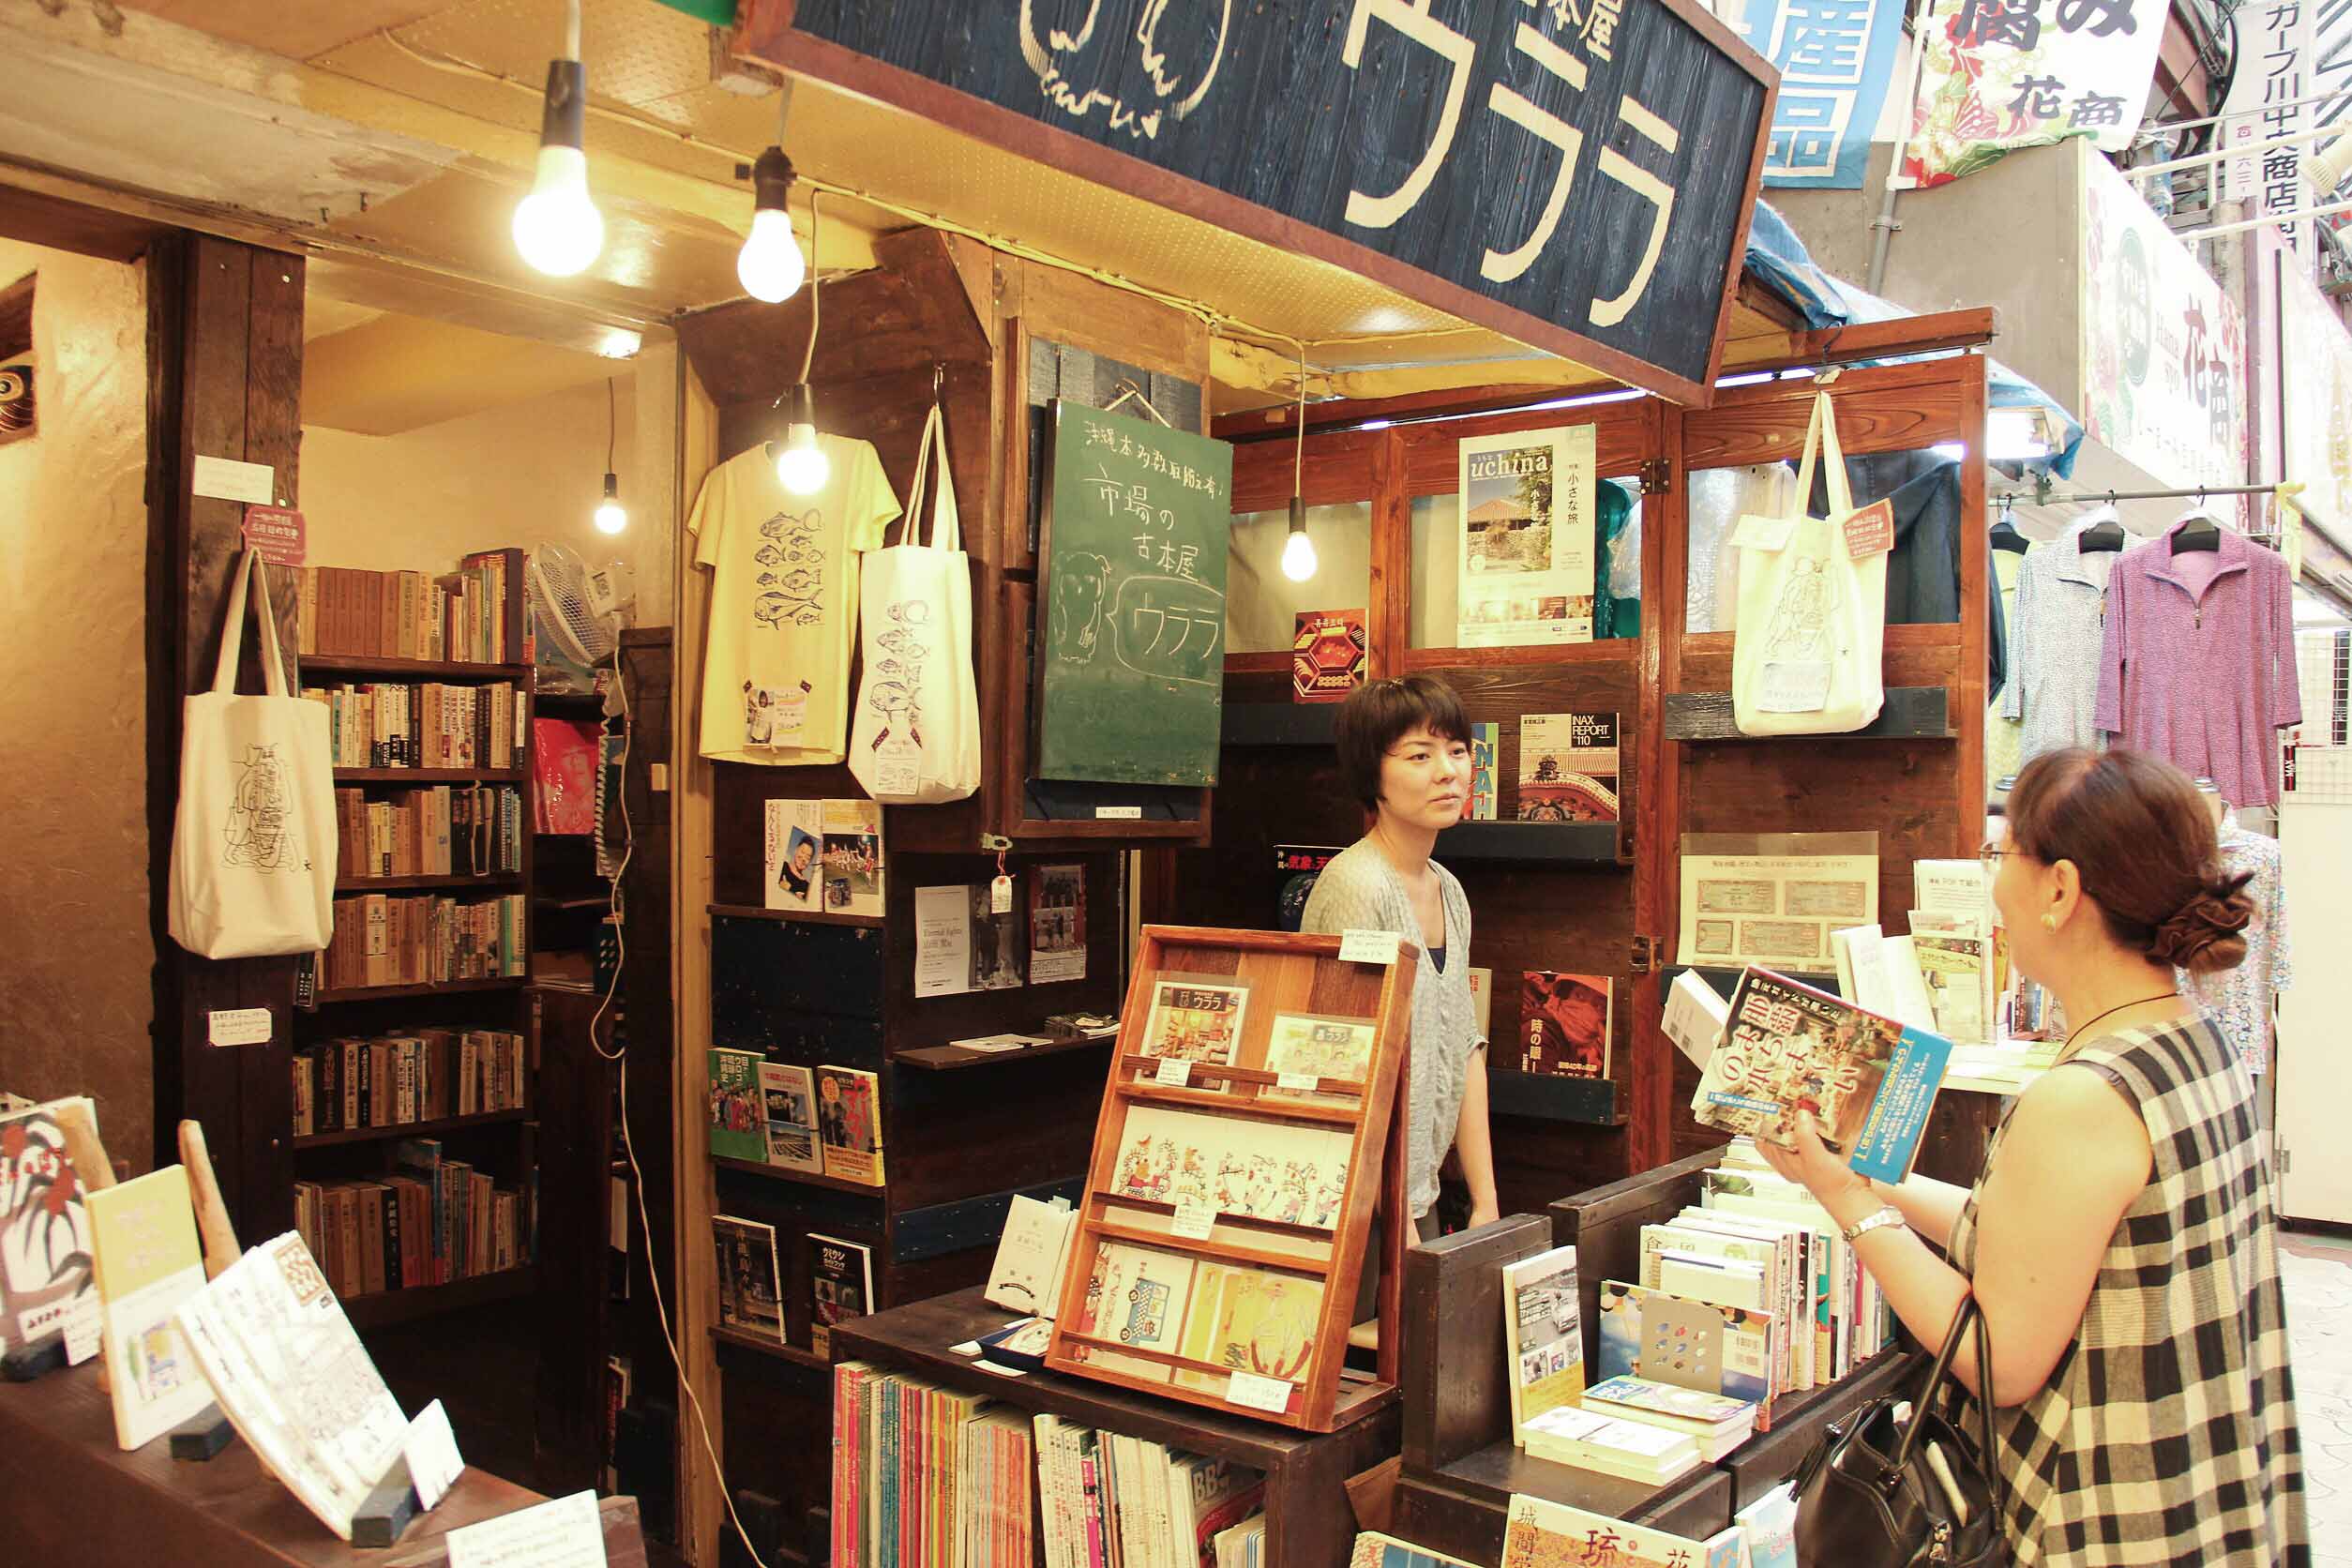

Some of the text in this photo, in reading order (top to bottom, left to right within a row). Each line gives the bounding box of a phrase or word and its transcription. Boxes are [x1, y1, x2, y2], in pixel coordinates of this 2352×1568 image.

[2007, 74, 2128, 129] 花商
[1340, 0, 1680, 329] ウララ
[1470, 452, 1550, 478] uchina
[1081, 463, 1176, 532] 市場の
[1567, 472, 1580, 525] 小さな旅
[1132, 535, 1200, 584] 古本屋
[1132, 592, 1220, 660] ウララ
[1572, 725, 1610, 736] REPORT
[1576, 736, 1591, 746] 110
[1193, 996, 1223, 1010] ウララ
[1740, 992, 1801, 1036] 那覇
